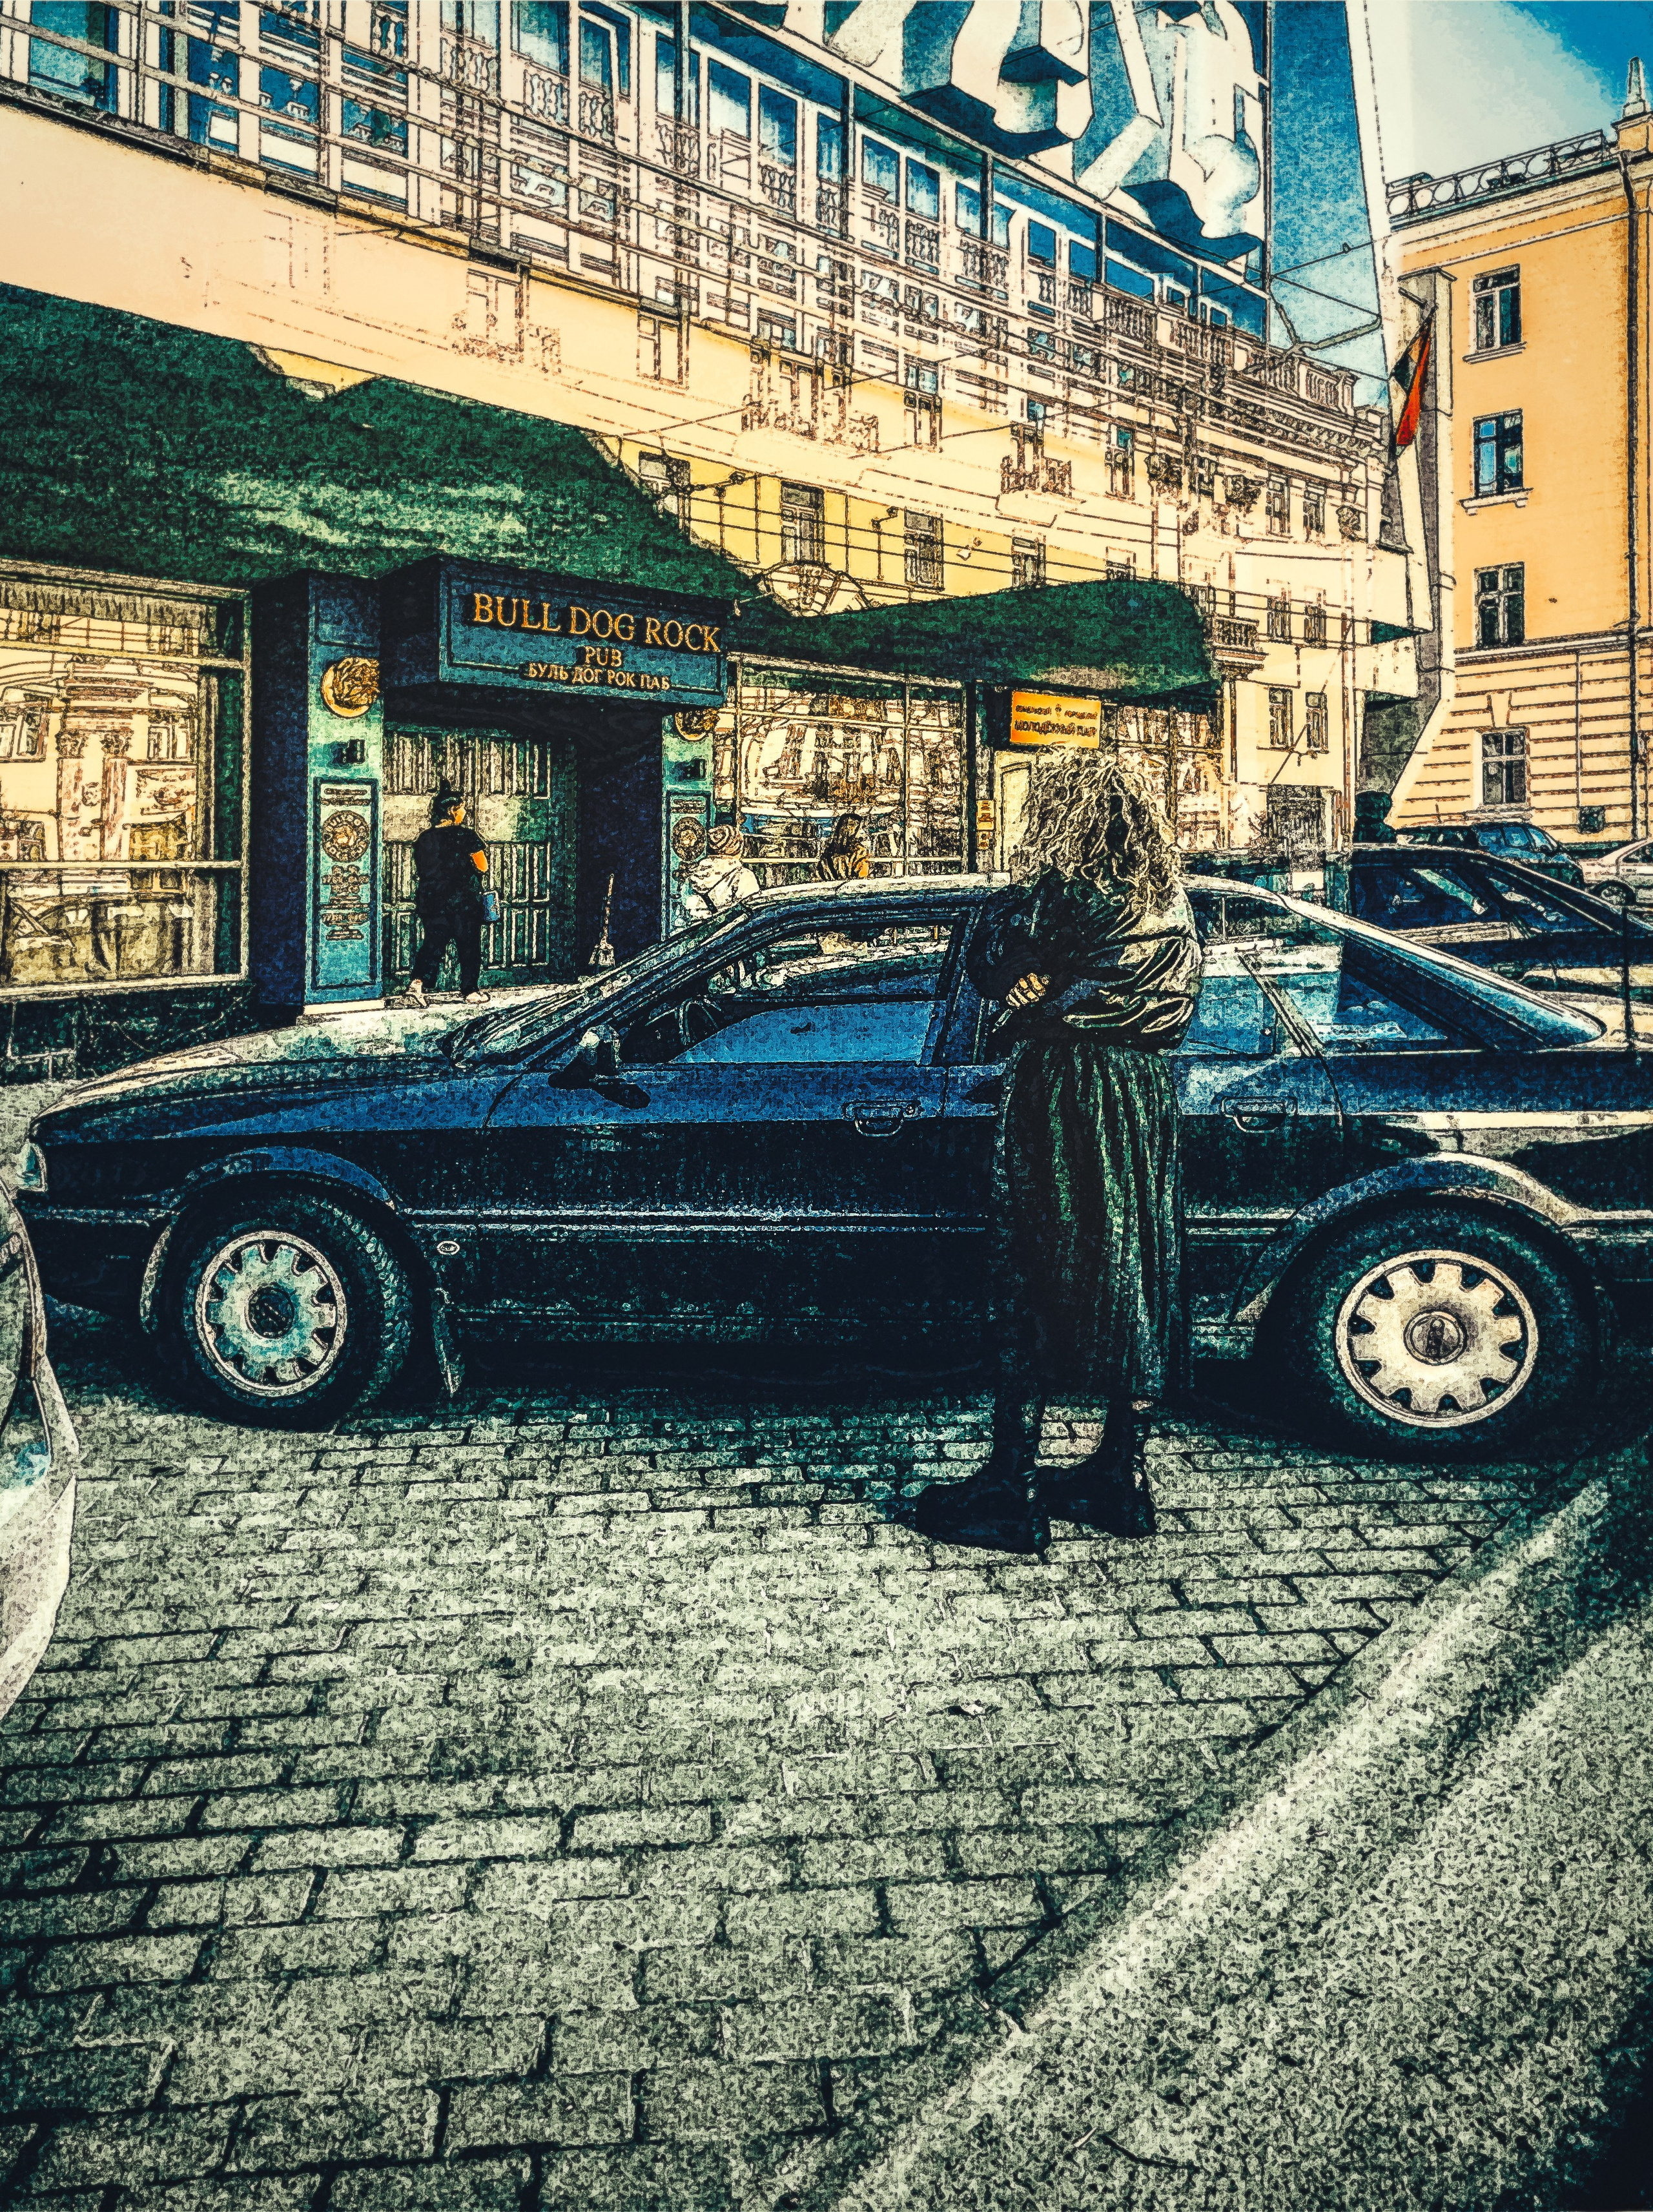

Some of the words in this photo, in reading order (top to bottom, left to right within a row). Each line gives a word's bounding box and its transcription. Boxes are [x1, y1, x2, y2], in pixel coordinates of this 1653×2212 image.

[473, 593, 560, 631] BULL
[570, 606, 634, 640] DOG
[645, 617, 721, 653] ROCK
[585, 646, 622, 666] PUB
[529, 662, 569, 681] БУЛЬ
[572, 666, 603, 684] ДОГ
[607, 670, 636, 688] РОК
[640, 673, 671, 691] ПАБ
